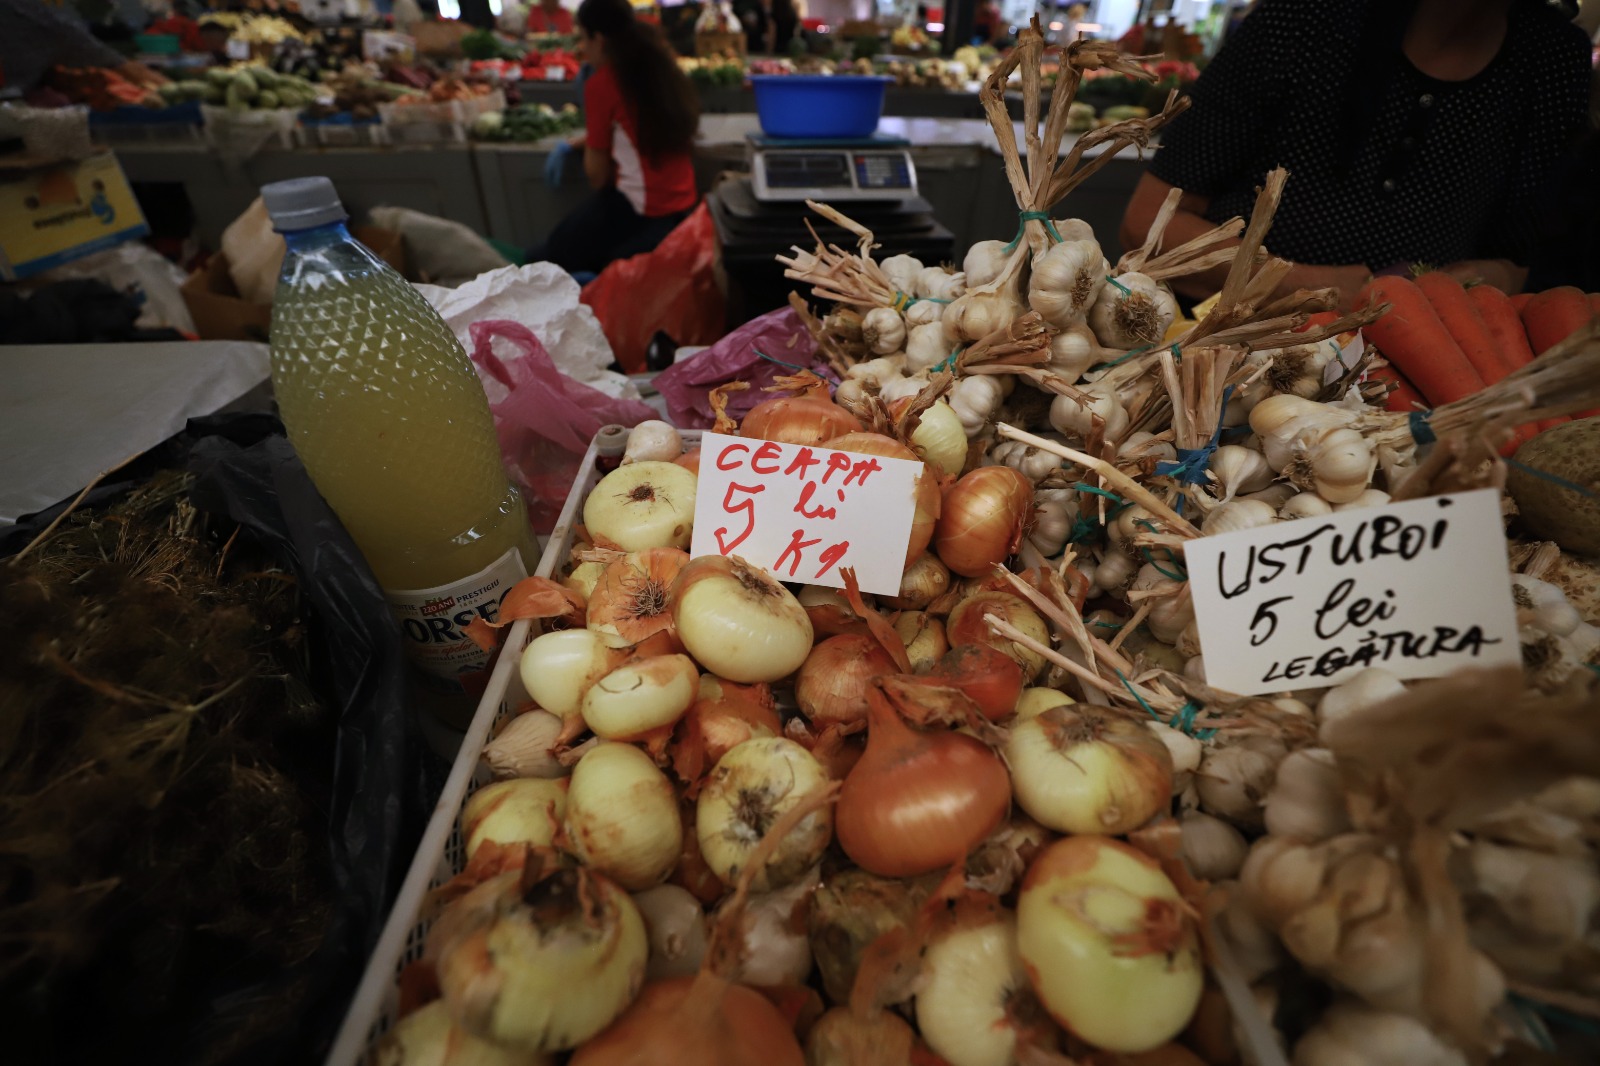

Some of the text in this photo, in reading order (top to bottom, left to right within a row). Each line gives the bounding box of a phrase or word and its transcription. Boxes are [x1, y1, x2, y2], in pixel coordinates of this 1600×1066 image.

[714, 481, 765, 556] 5
[422, 605, 437, 614] 220
[438, 599, 454, 609] ANI
[456, 579, 500, 604] PRESTIGIU
[1249, 578, 1397, 647] 5 lei
